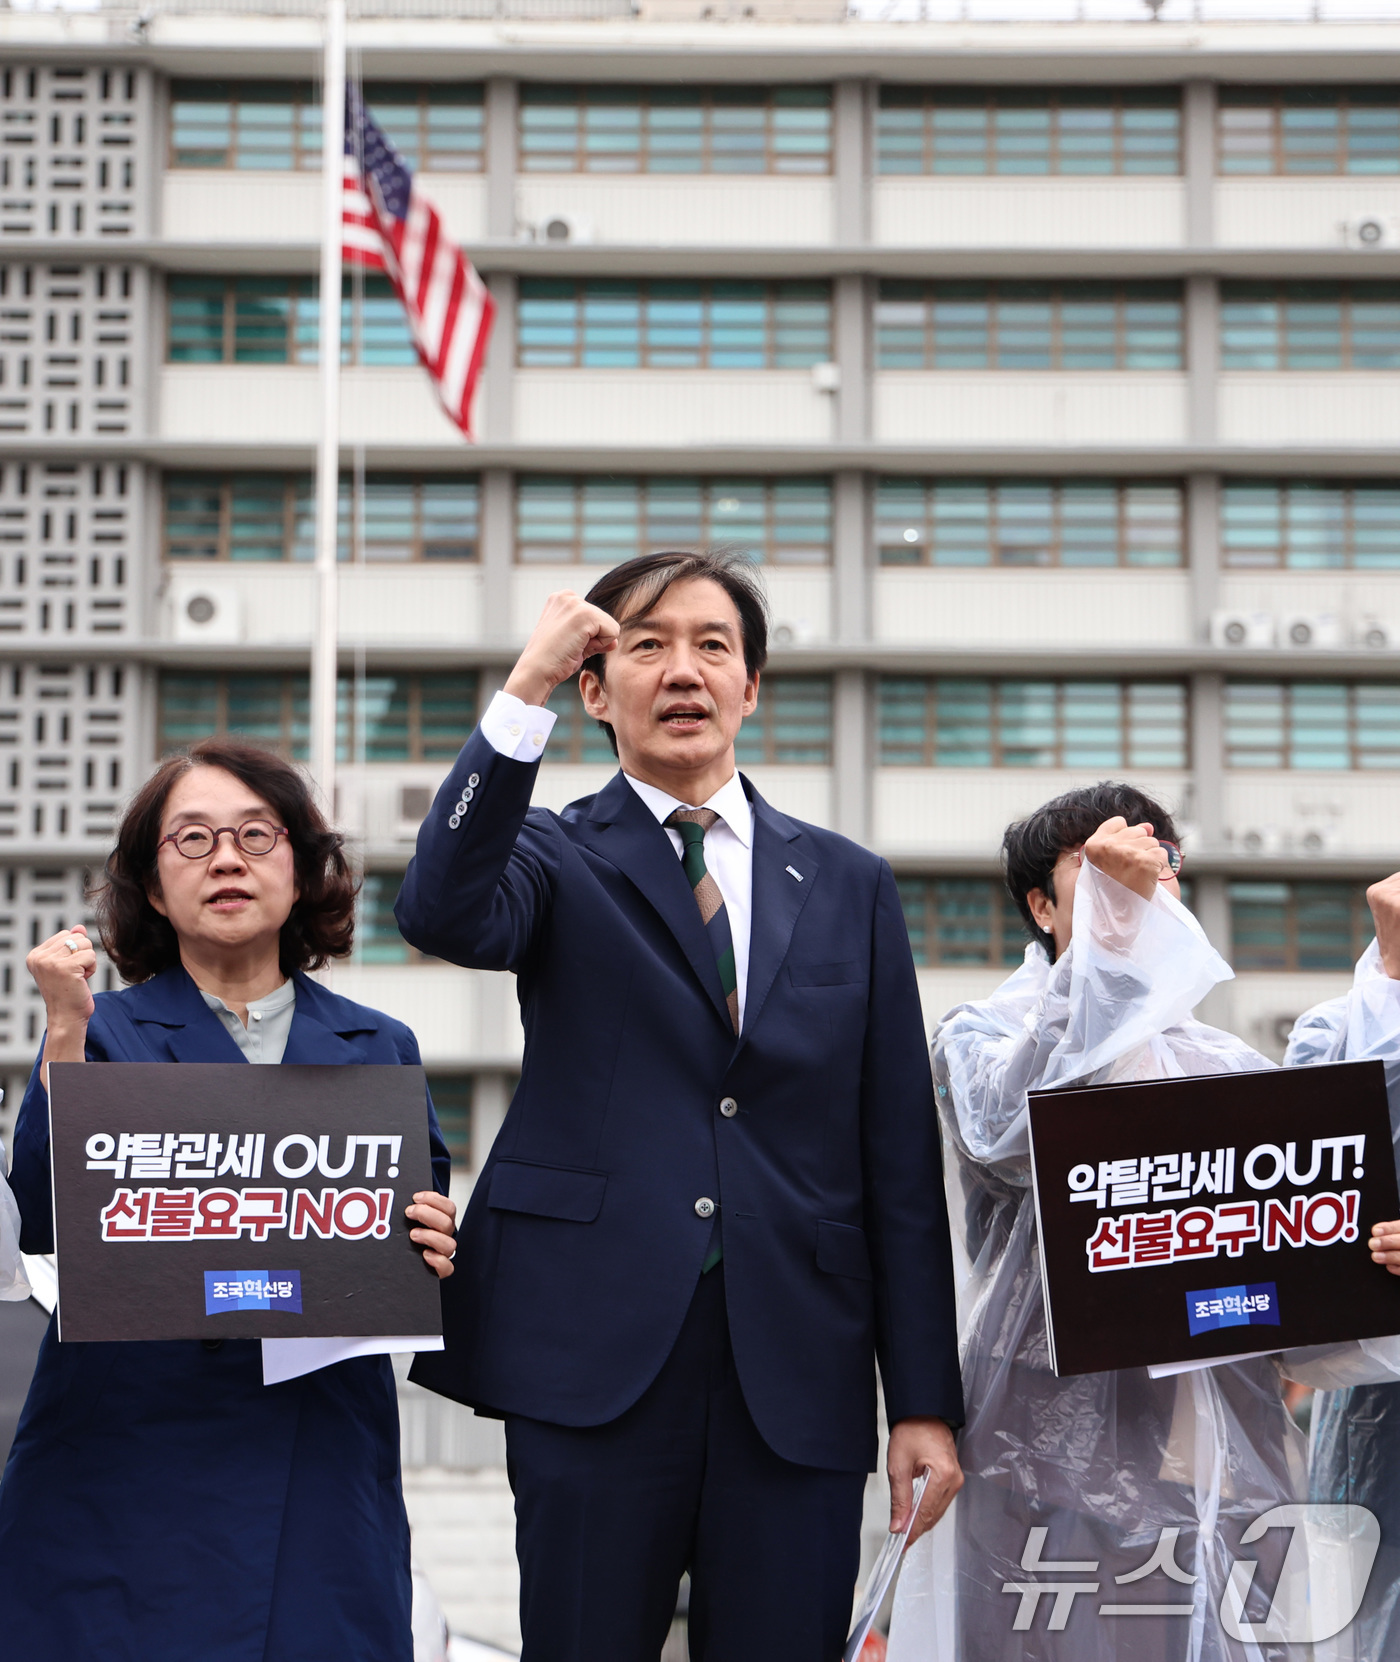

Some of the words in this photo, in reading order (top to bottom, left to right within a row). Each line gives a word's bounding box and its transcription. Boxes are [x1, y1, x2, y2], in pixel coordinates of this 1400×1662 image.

[85, 1133, 265, 1179] 약탈관세
[272, 1134, 402, 1179] OUT!
[1067, 1147, 1235, 1209] 약탈관세
[1243, 1134, 1366, 1190] OUT!
[101, 1187, 288, 1242] 선불요구
[289, 1188, 394, 1240] NO!
[1086, 1200, 1260, 1273] 선불요구
[1262, 1190, 1361, 1251] NO!
[213, 1280, 293, 1300] 조국혁신당
[1194, 1294, 1270, 1318] 조국혁신당
